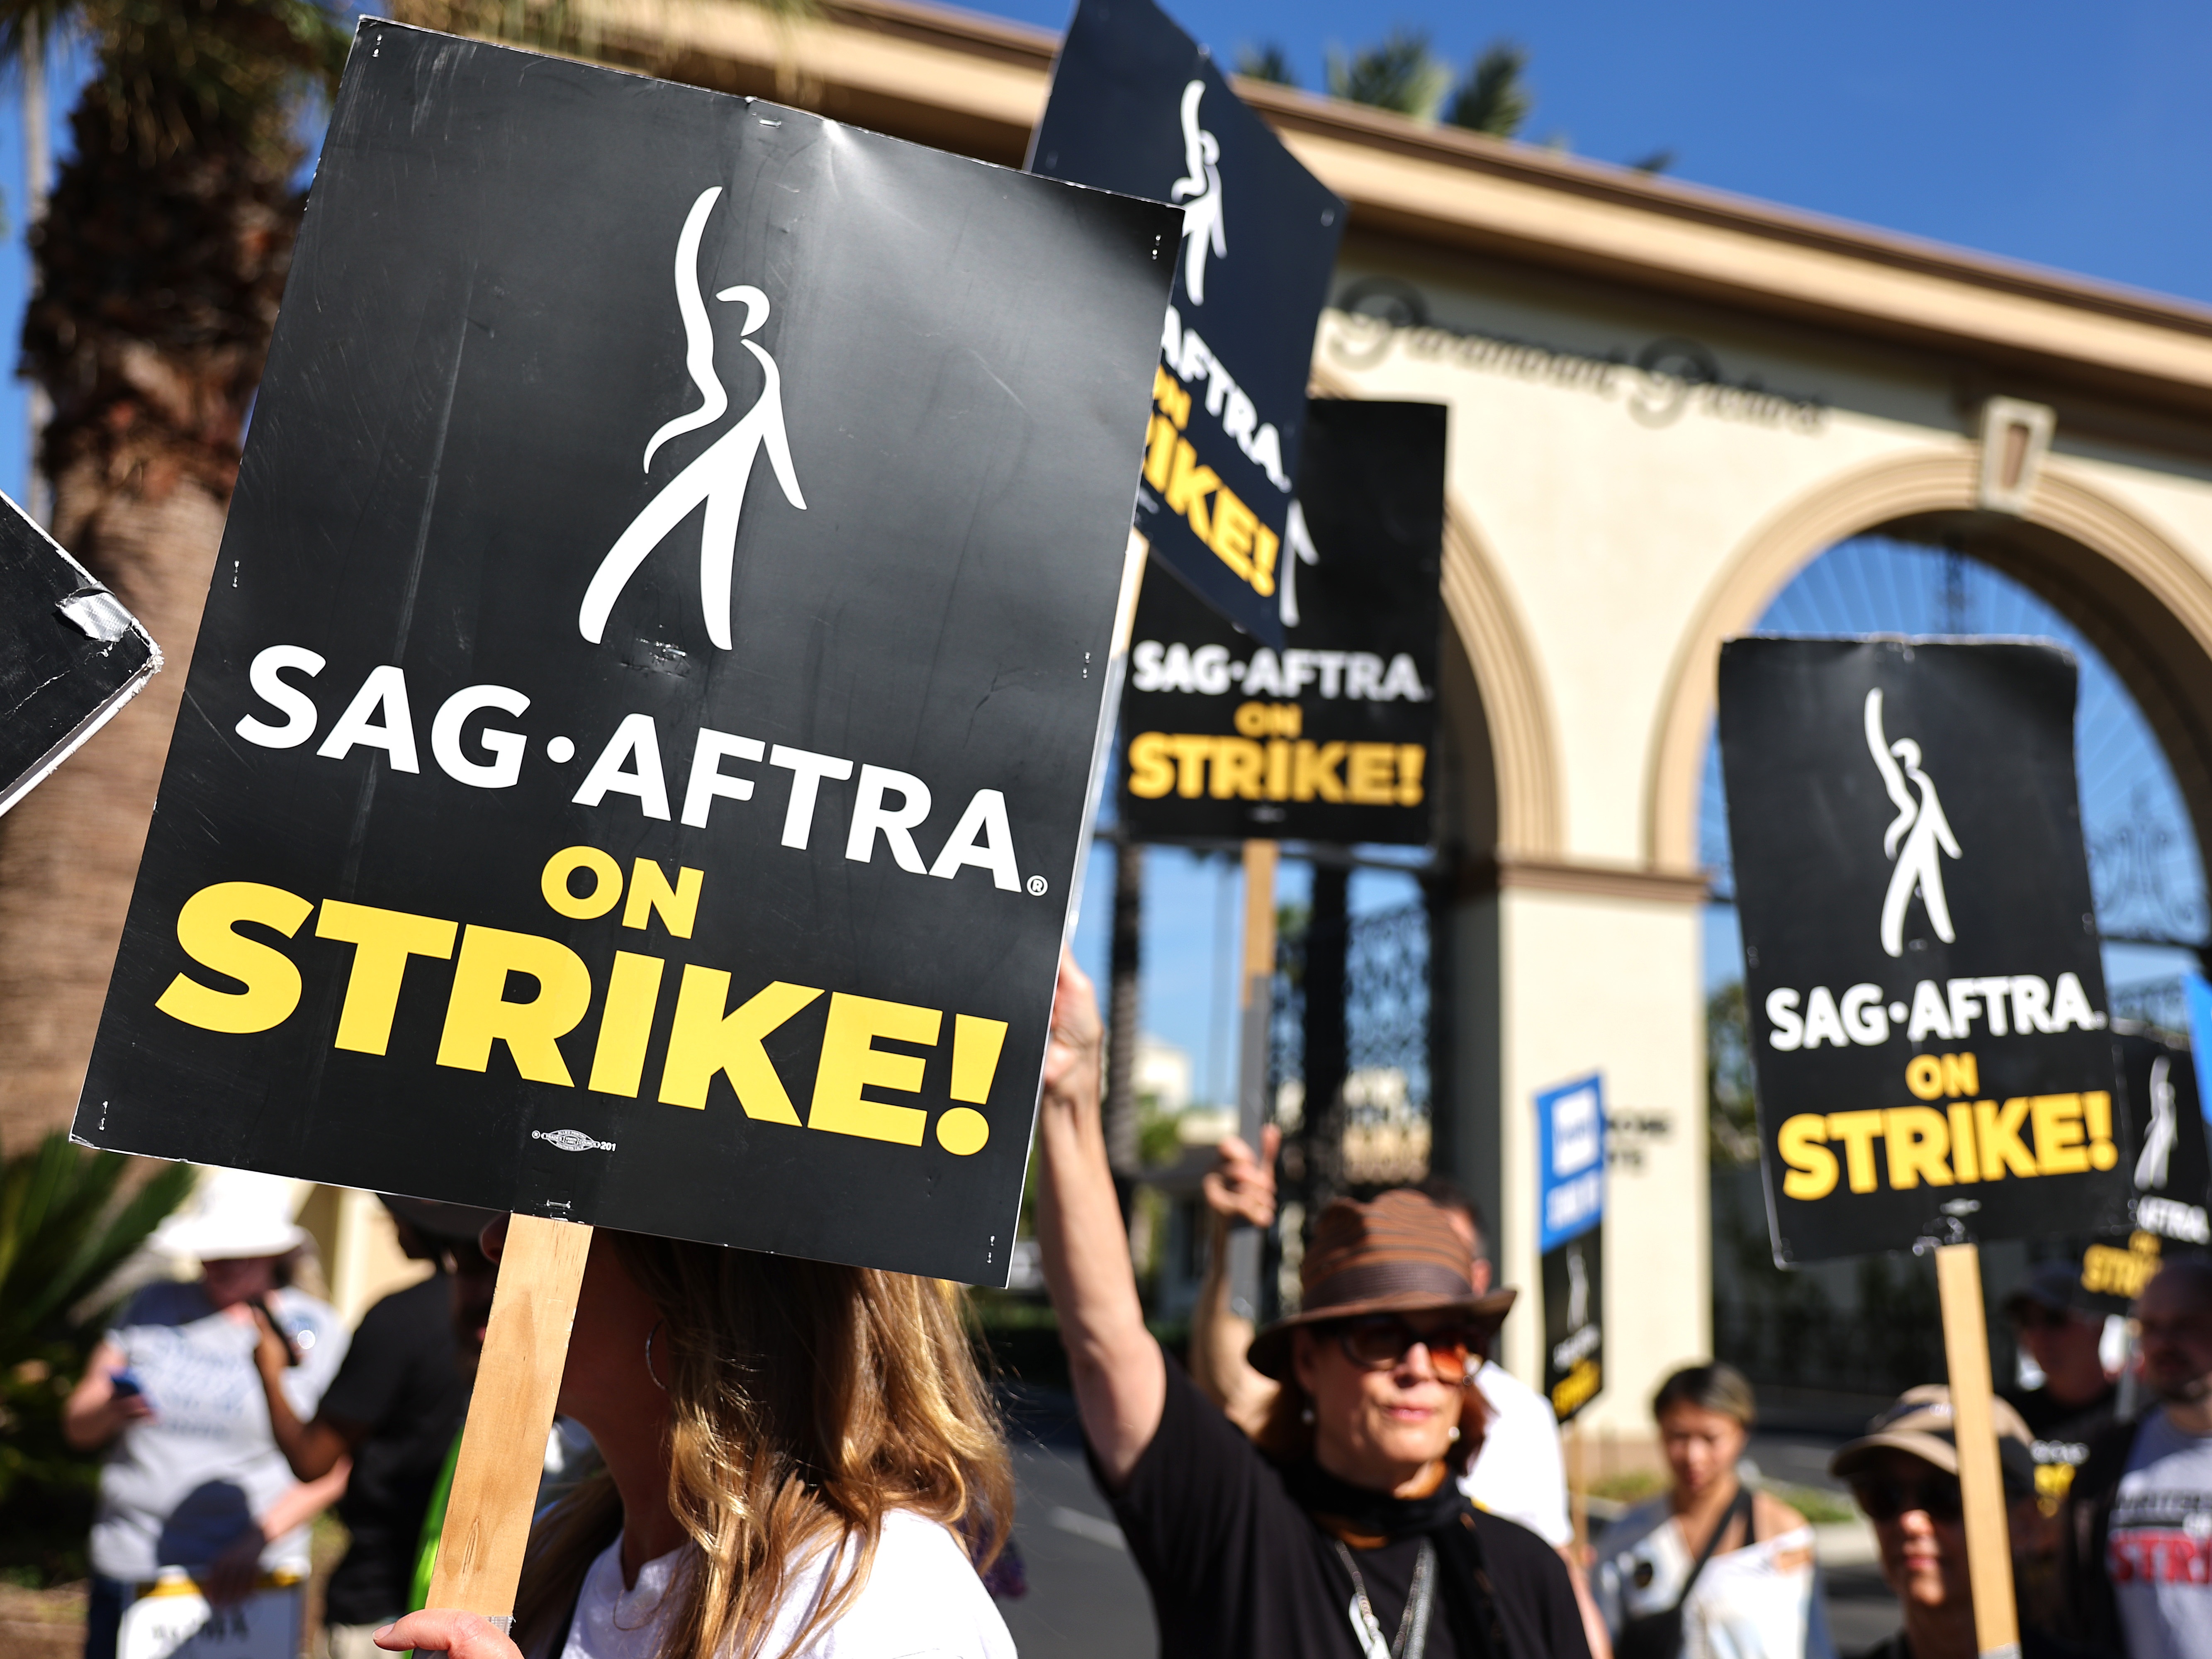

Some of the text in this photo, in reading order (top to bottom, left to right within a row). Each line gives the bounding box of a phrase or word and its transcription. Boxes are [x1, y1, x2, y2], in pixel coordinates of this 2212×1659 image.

[1143, 411, 1280, 597] IKE!
[1234, 701, 1303, 738] ON
[1128, 730, 1426, 808] STRIKE!
[540, 845, 704, 940] ON
[154, 881, 1009, 1156] STRIKE!
[1905, 1051, 1980, 1101] ON
[600, 1141, 616, 1152] 201
[1777, 1090, 2118, 1201] STRIKE!
